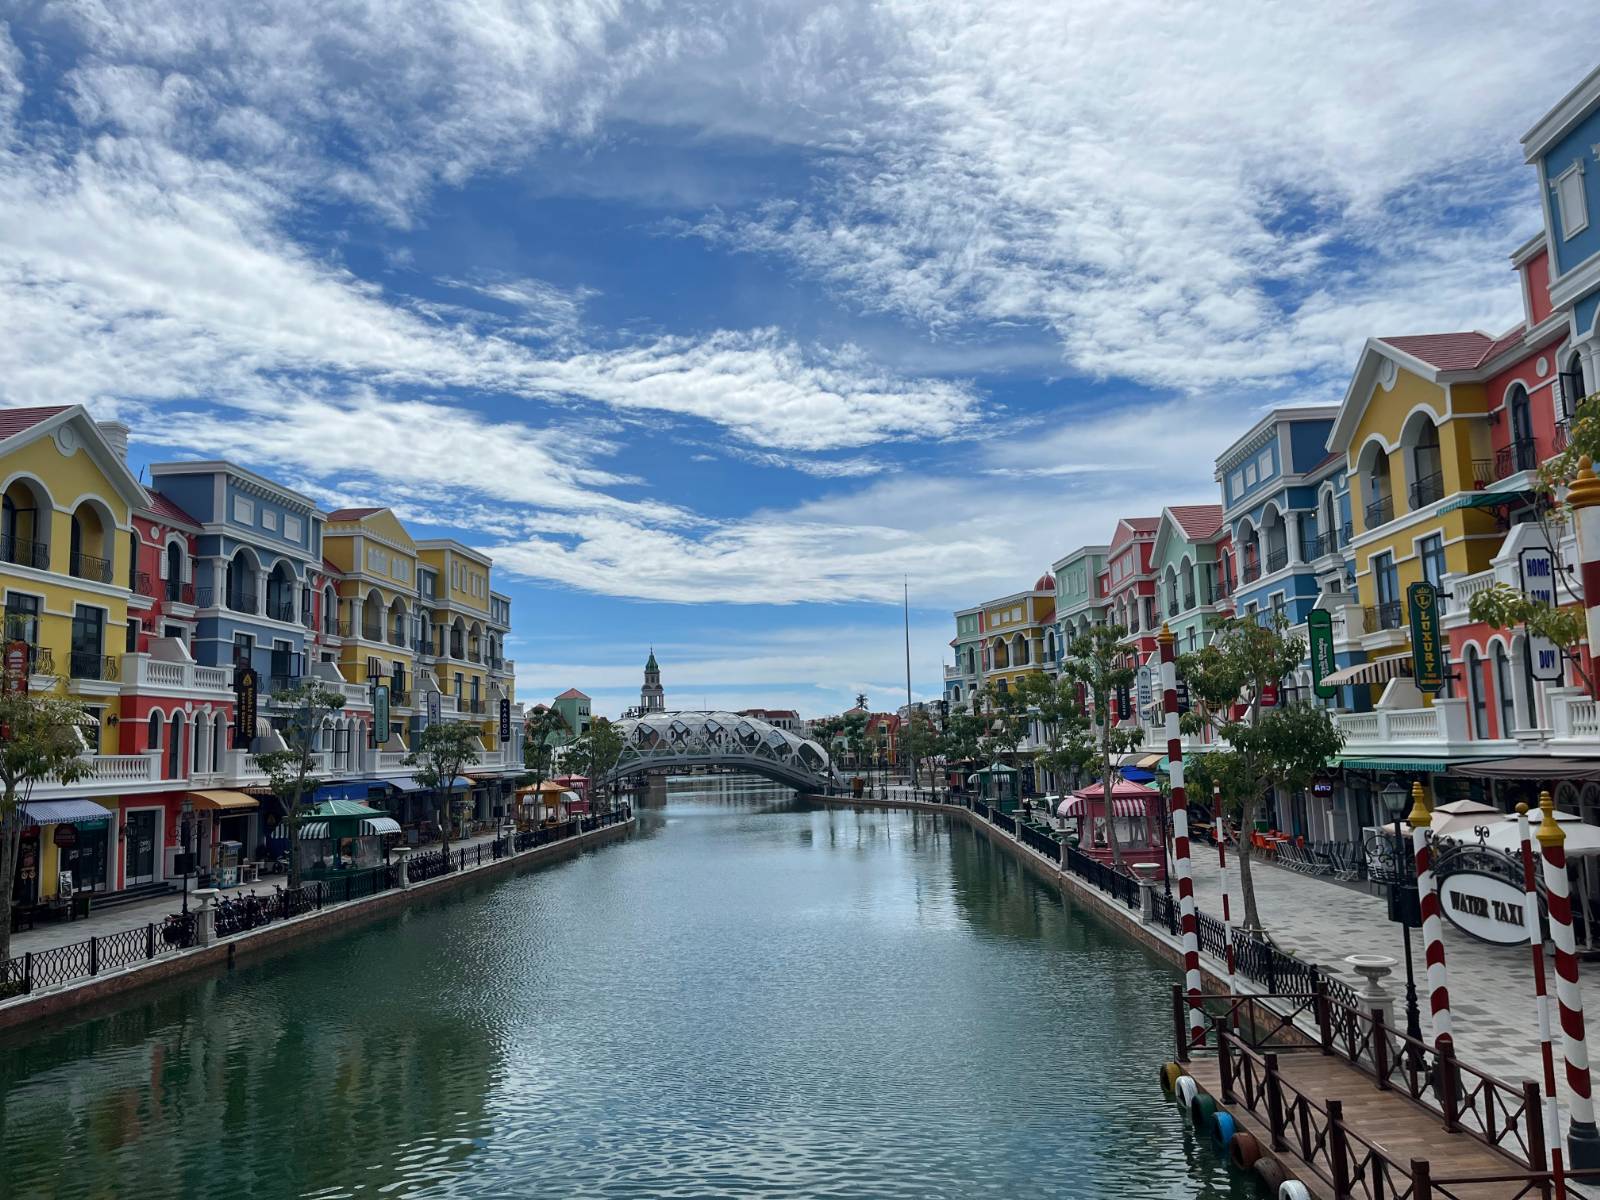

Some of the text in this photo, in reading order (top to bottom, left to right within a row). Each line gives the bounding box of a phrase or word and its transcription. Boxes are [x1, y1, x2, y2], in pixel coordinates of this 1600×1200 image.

[1526, 558, 1550, 577] HOME
[1420, 611, 1435, 673] LUXURY
[1539, 650, 1555, 669] DUY
[1449, 890, 1525, 927] WATER TAXI
